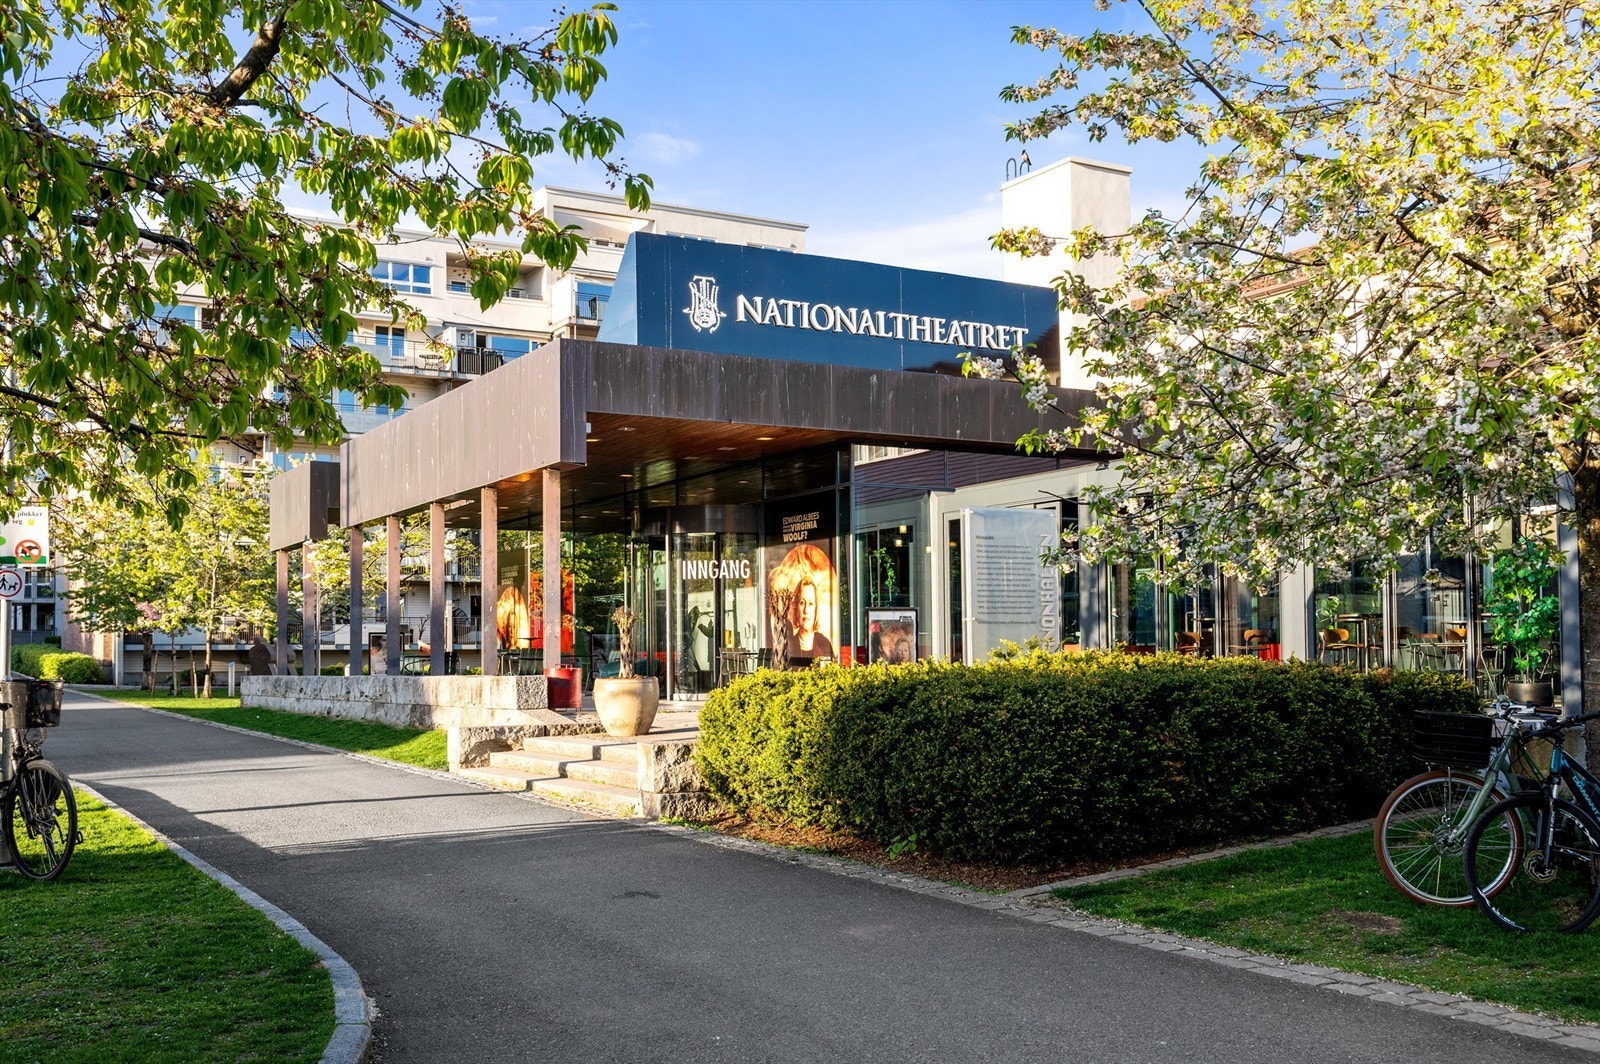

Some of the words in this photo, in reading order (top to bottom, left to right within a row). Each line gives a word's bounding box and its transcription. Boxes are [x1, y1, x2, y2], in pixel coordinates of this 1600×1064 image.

[736, 294, 1029, 350] NATIONALTHEATRET
[782, 514, 802, 525] EDWARD
[803, 511, 820, 521] ALBEES
[790, 520, 818, 532] VIRGINIA
[782, 531, 808, 543] WOOLF?
[682, 559, 751, 580] INNGANG
[1572, 775, 1600, 815] DIAMANT
